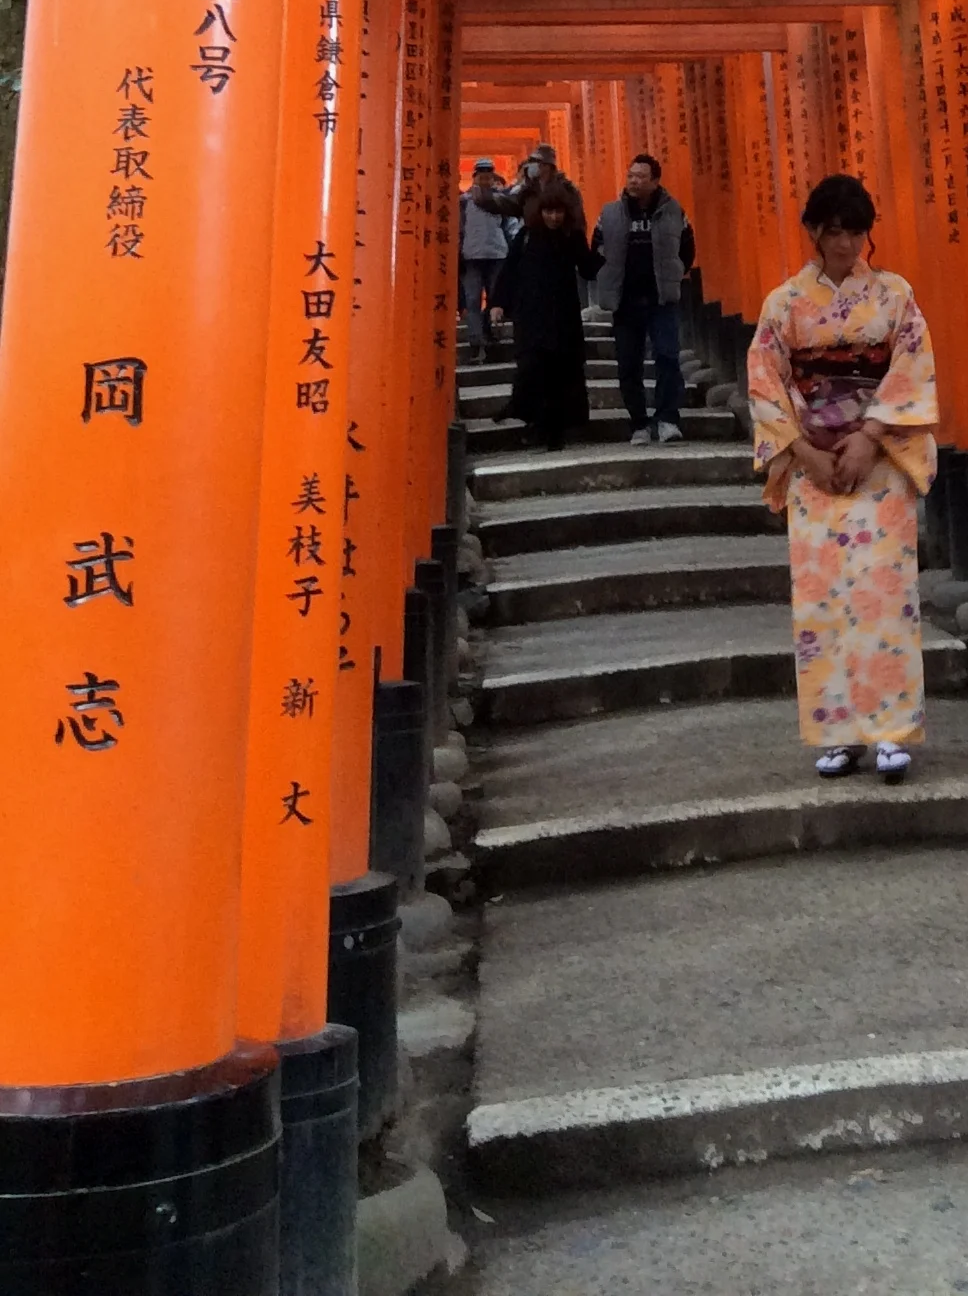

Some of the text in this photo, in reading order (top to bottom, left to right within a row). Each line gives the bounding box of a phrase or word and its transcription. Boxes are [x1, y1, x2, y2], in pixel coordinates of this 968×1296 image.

[105, 66, 154, 261] 代表取締役
